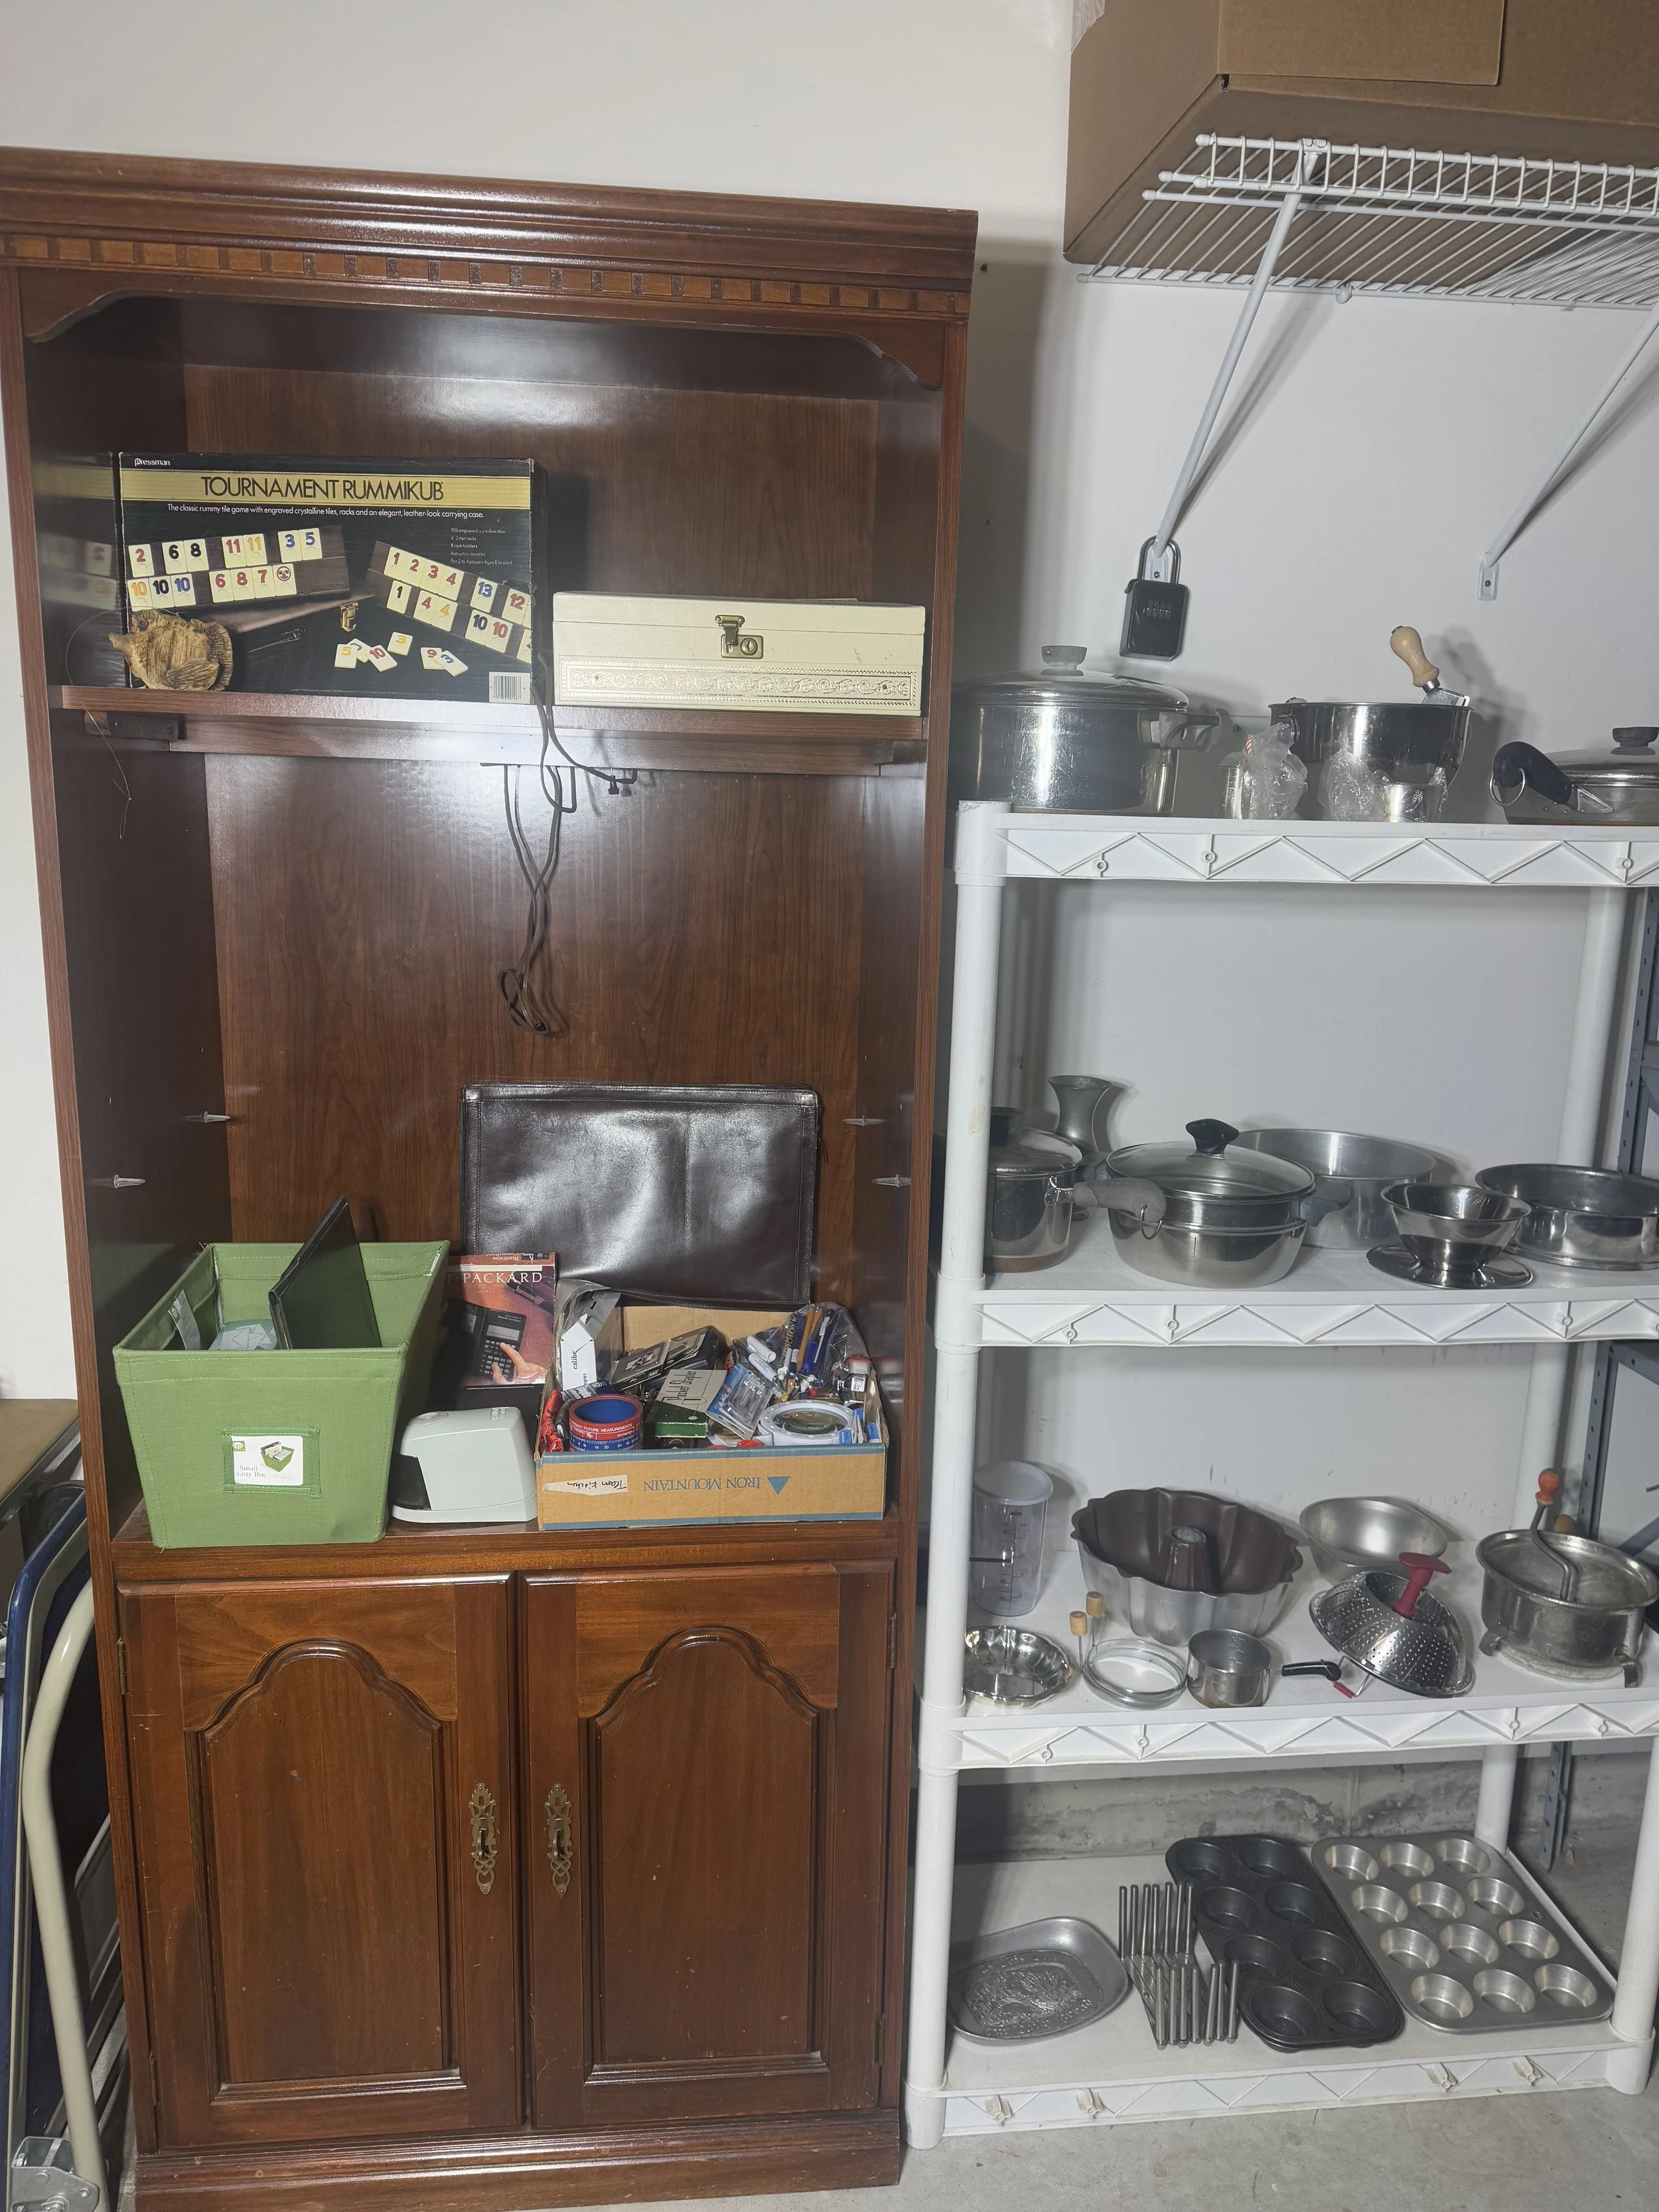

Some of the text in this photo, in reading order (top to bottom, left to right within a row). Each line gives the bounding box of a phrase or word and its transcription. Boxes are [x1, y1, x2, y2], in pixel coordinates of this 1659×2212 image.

[134, 457, 171, 467] Pressman
[200, 476, 444, 501] TOURNAMENT RUMMIKUB
[263, 506, 293, 516] engraved
[294, 506, 325, 516] crystalline
[325, 507, 338, 516] tiles,
[378, 508, 403, 518] elegant,
[441, 510, 467, 519] carrying
[135, 532, 317, 562] 2 6 8 11 11 3 5
[130, 569, 267, 597] 10 10 10 6 8 7
[394, 552, 526, 610] 1 2 3 4 13 12
[396, 585, 508, 638] 1 4 4 10 10
[341, 646, 352, 656] 5
[369, 647, 386, 659] 10
[670, 1370, 703, 1386] Stapler
[601, 1423, 632, 1434] MEASUREMENTS
[602, 1479, 626, 1491] Team
[643, 1476, 762, 1491] IRON MOUNTAIN
